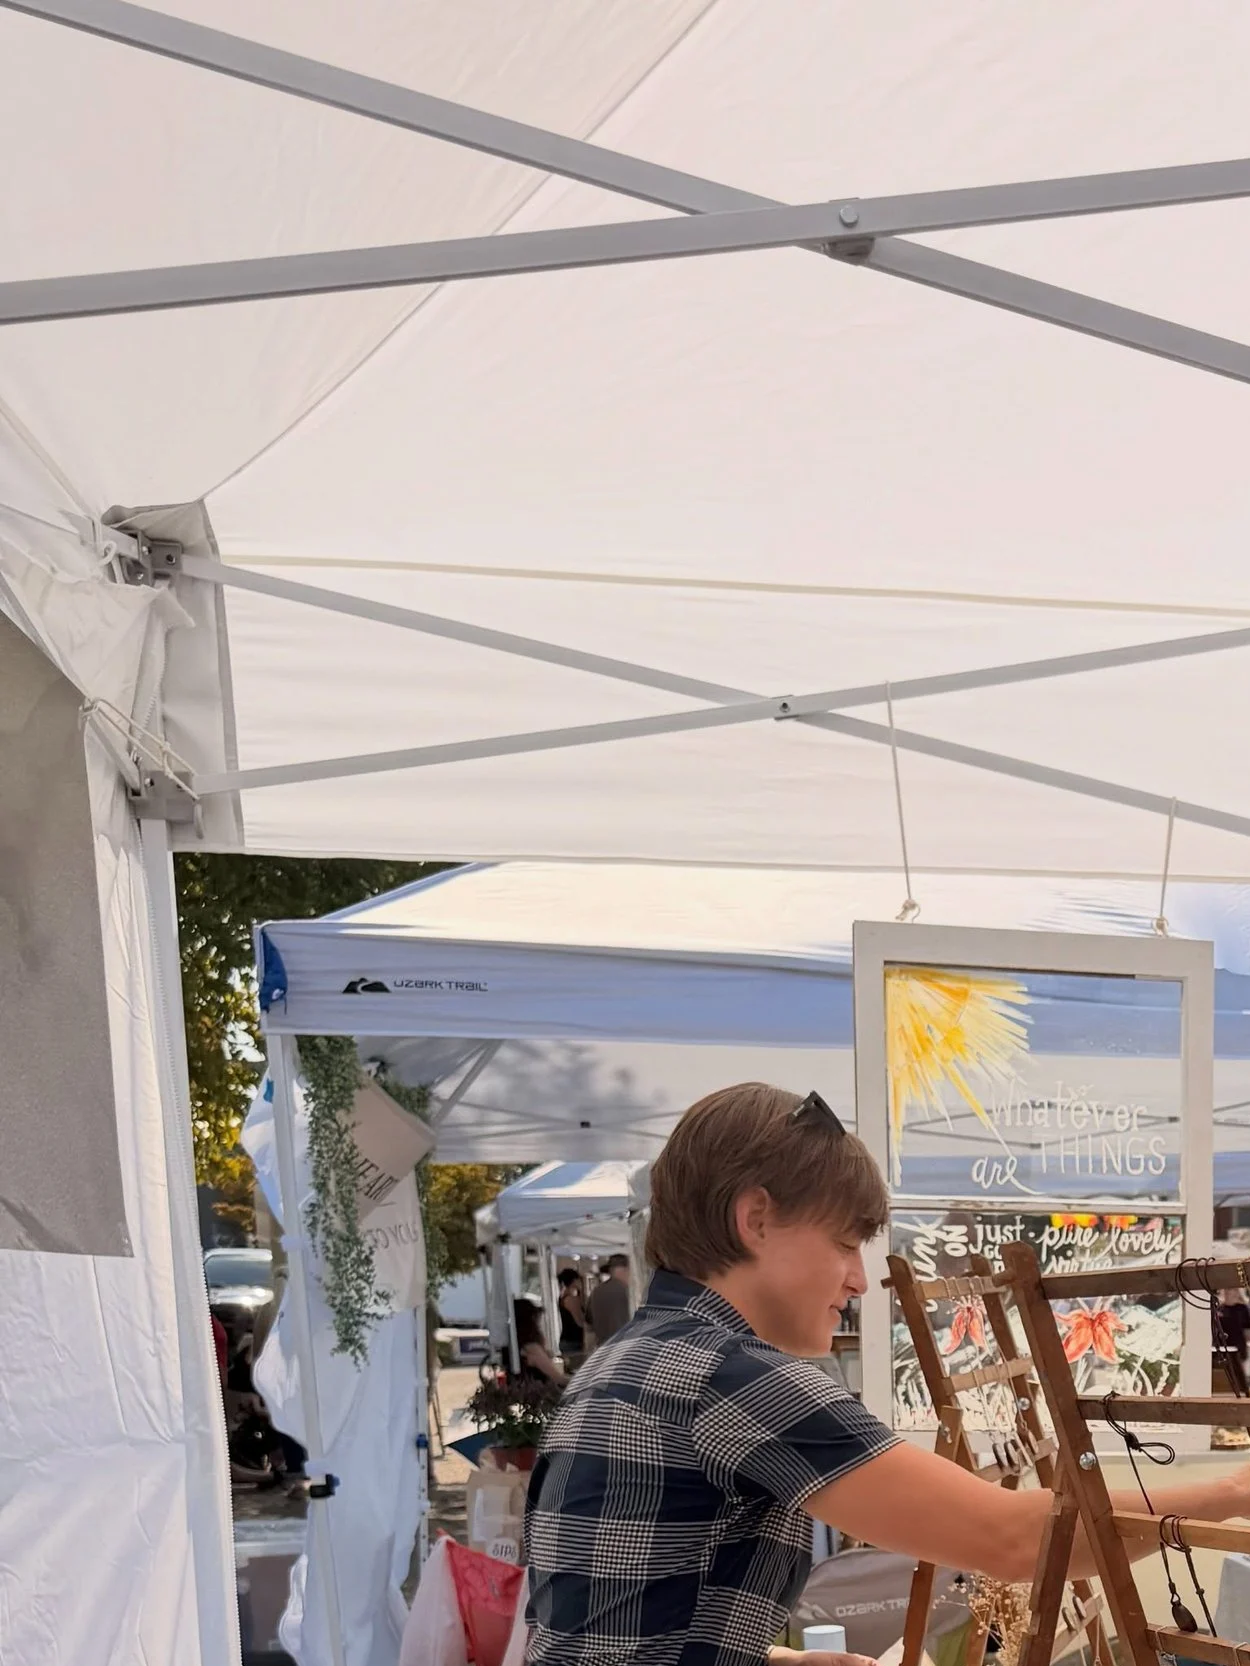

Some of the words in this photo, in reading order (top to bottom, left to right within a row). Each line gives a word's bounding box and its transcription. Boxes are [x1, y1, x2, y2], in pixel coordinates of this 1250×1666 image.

[971, 1154, 1047, 1196] are
[1032, 1131, 1168, 1176] THINGS
[968, 1214, 1026, 1255] just
[1034, 1224, 1100, 1263] pure
[1096, 1223, 1184, 1265] lovely
